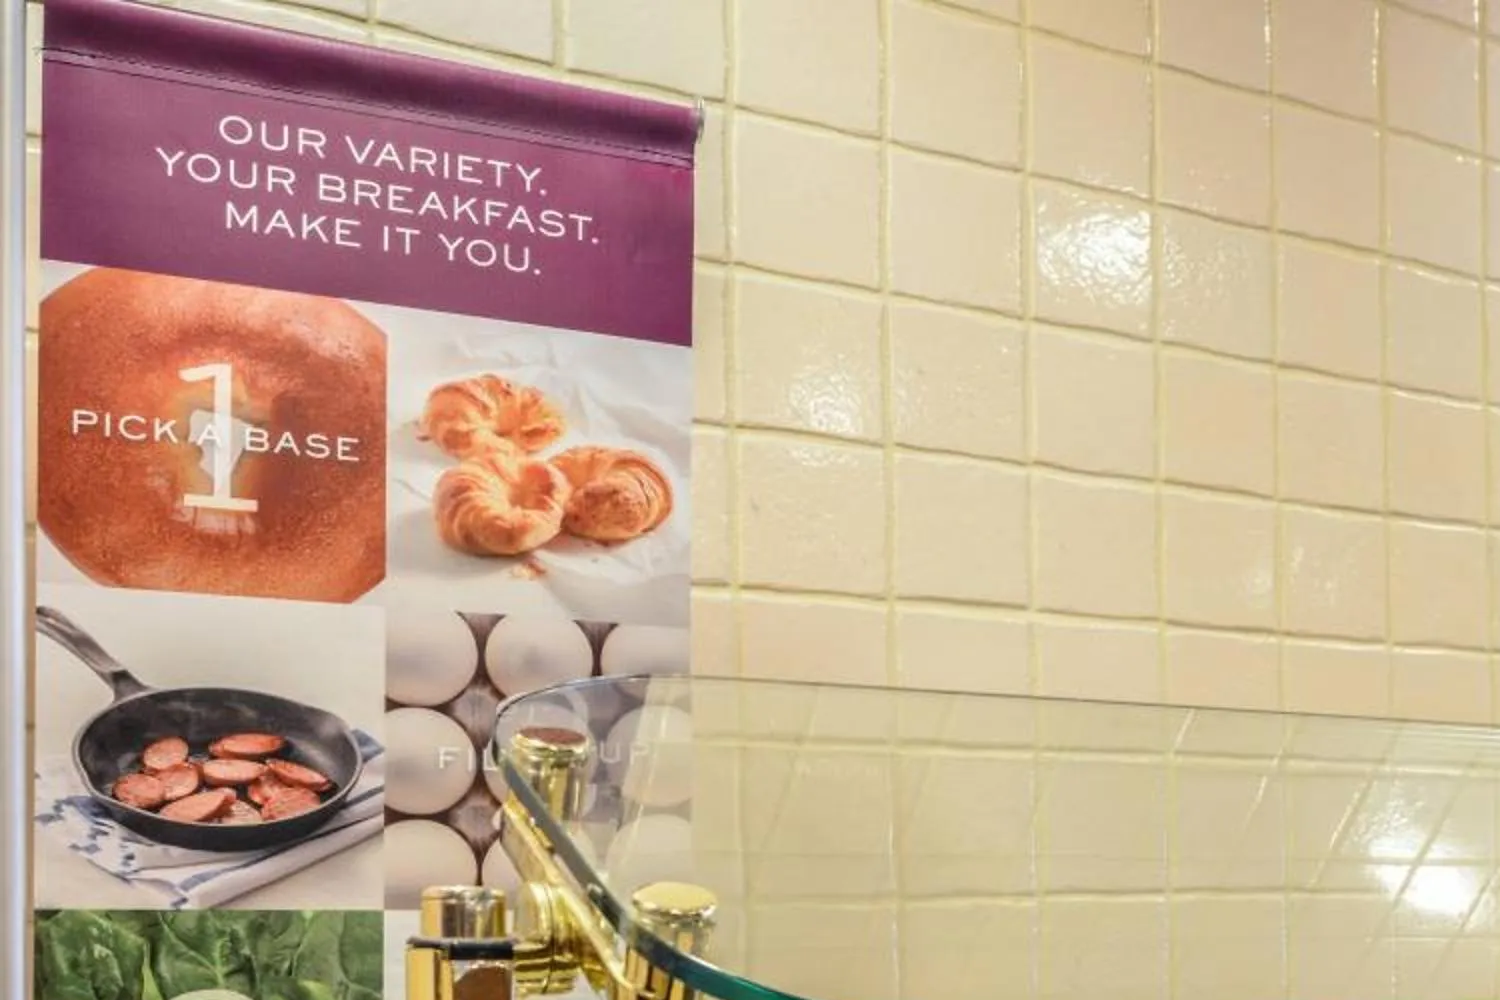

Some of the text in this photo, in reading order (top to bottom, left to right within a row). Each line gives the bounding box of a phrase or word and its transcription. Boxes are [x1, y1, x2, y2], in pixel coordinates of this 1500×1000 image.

[218, 115, 548, 197] OUR VARIETY.
[155, 147, 600, 245] YOUR BREAKFAST.
[225, 202, 543, 276] MAKE IT YOU.
[72, 410, 360, 462] PICK A BASE
[178, 363, 259, 514] 1
[438, 746, 499, 772] FIL
